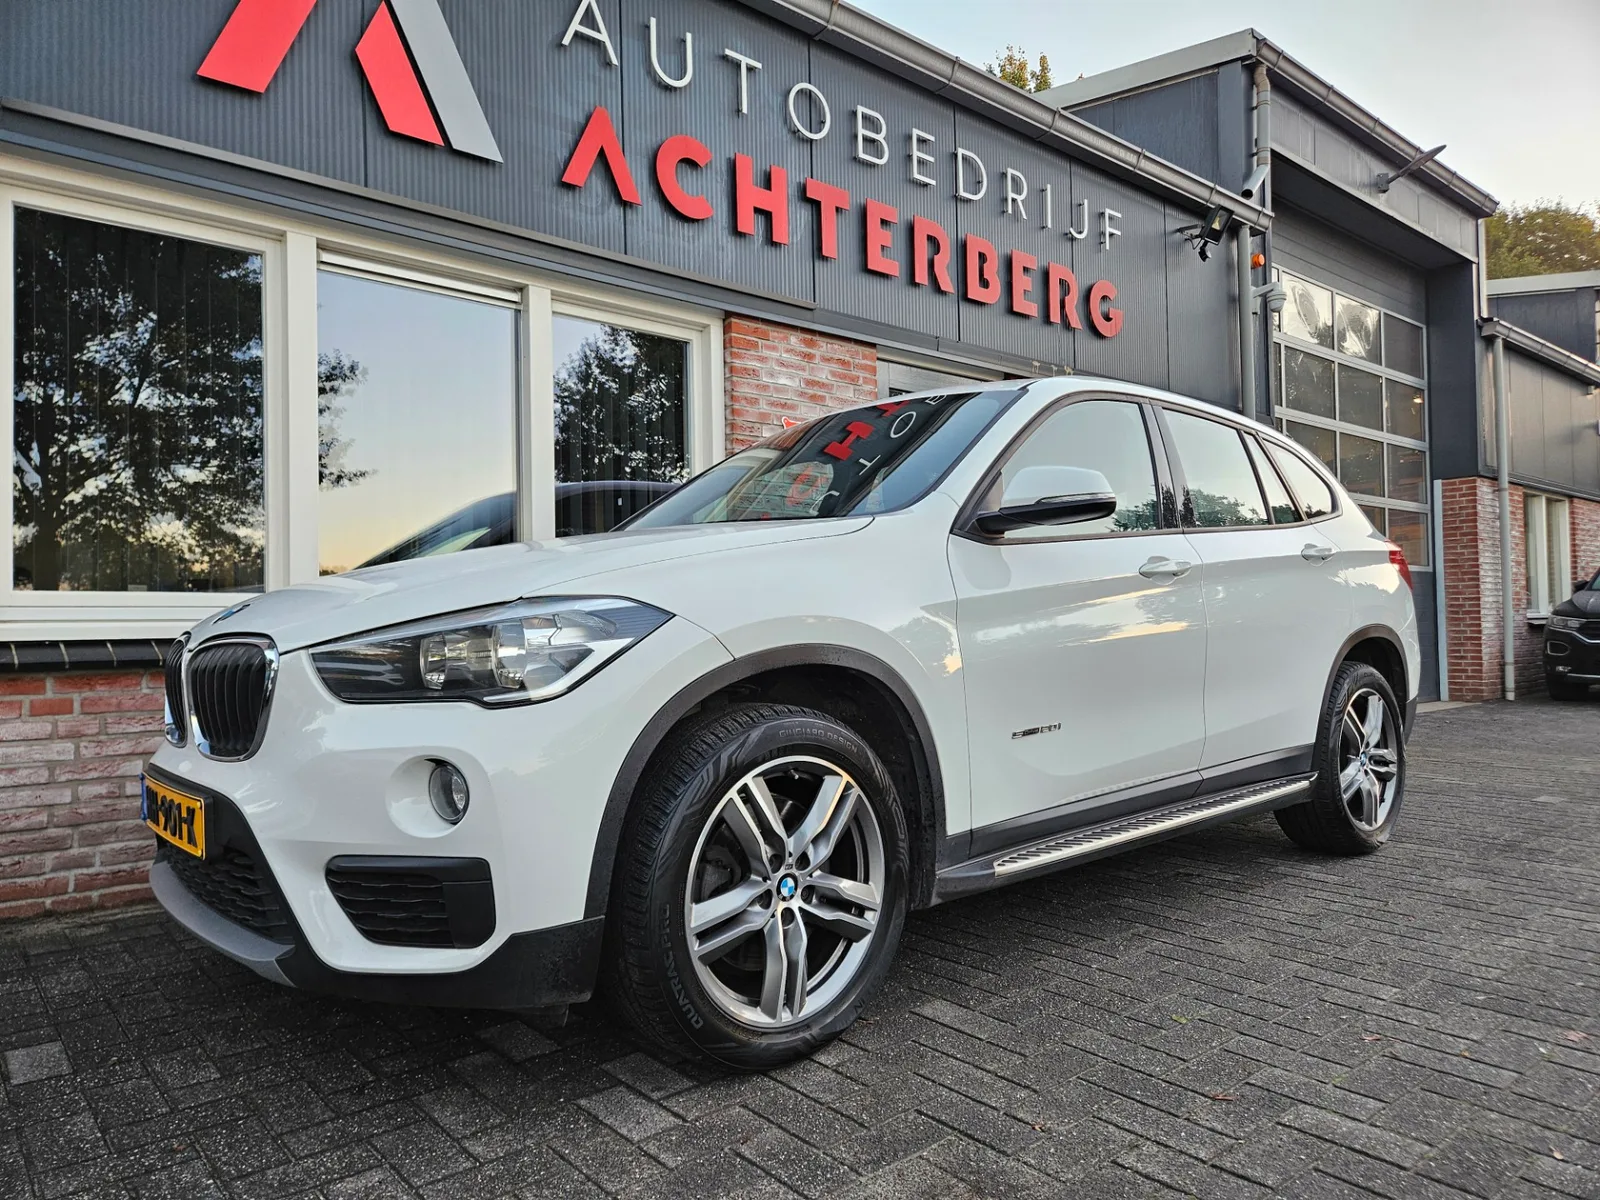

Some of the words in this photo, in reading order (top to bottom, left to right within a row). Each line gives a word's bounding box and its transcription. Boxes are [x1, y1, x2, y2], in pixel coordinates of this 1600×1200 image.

[561, 0, 1122, 250] AUTOBEDRIJF
[562, 106, 1124, 338] ACHTERBERG
[664, 951, 704, 1030] QUATRAC
